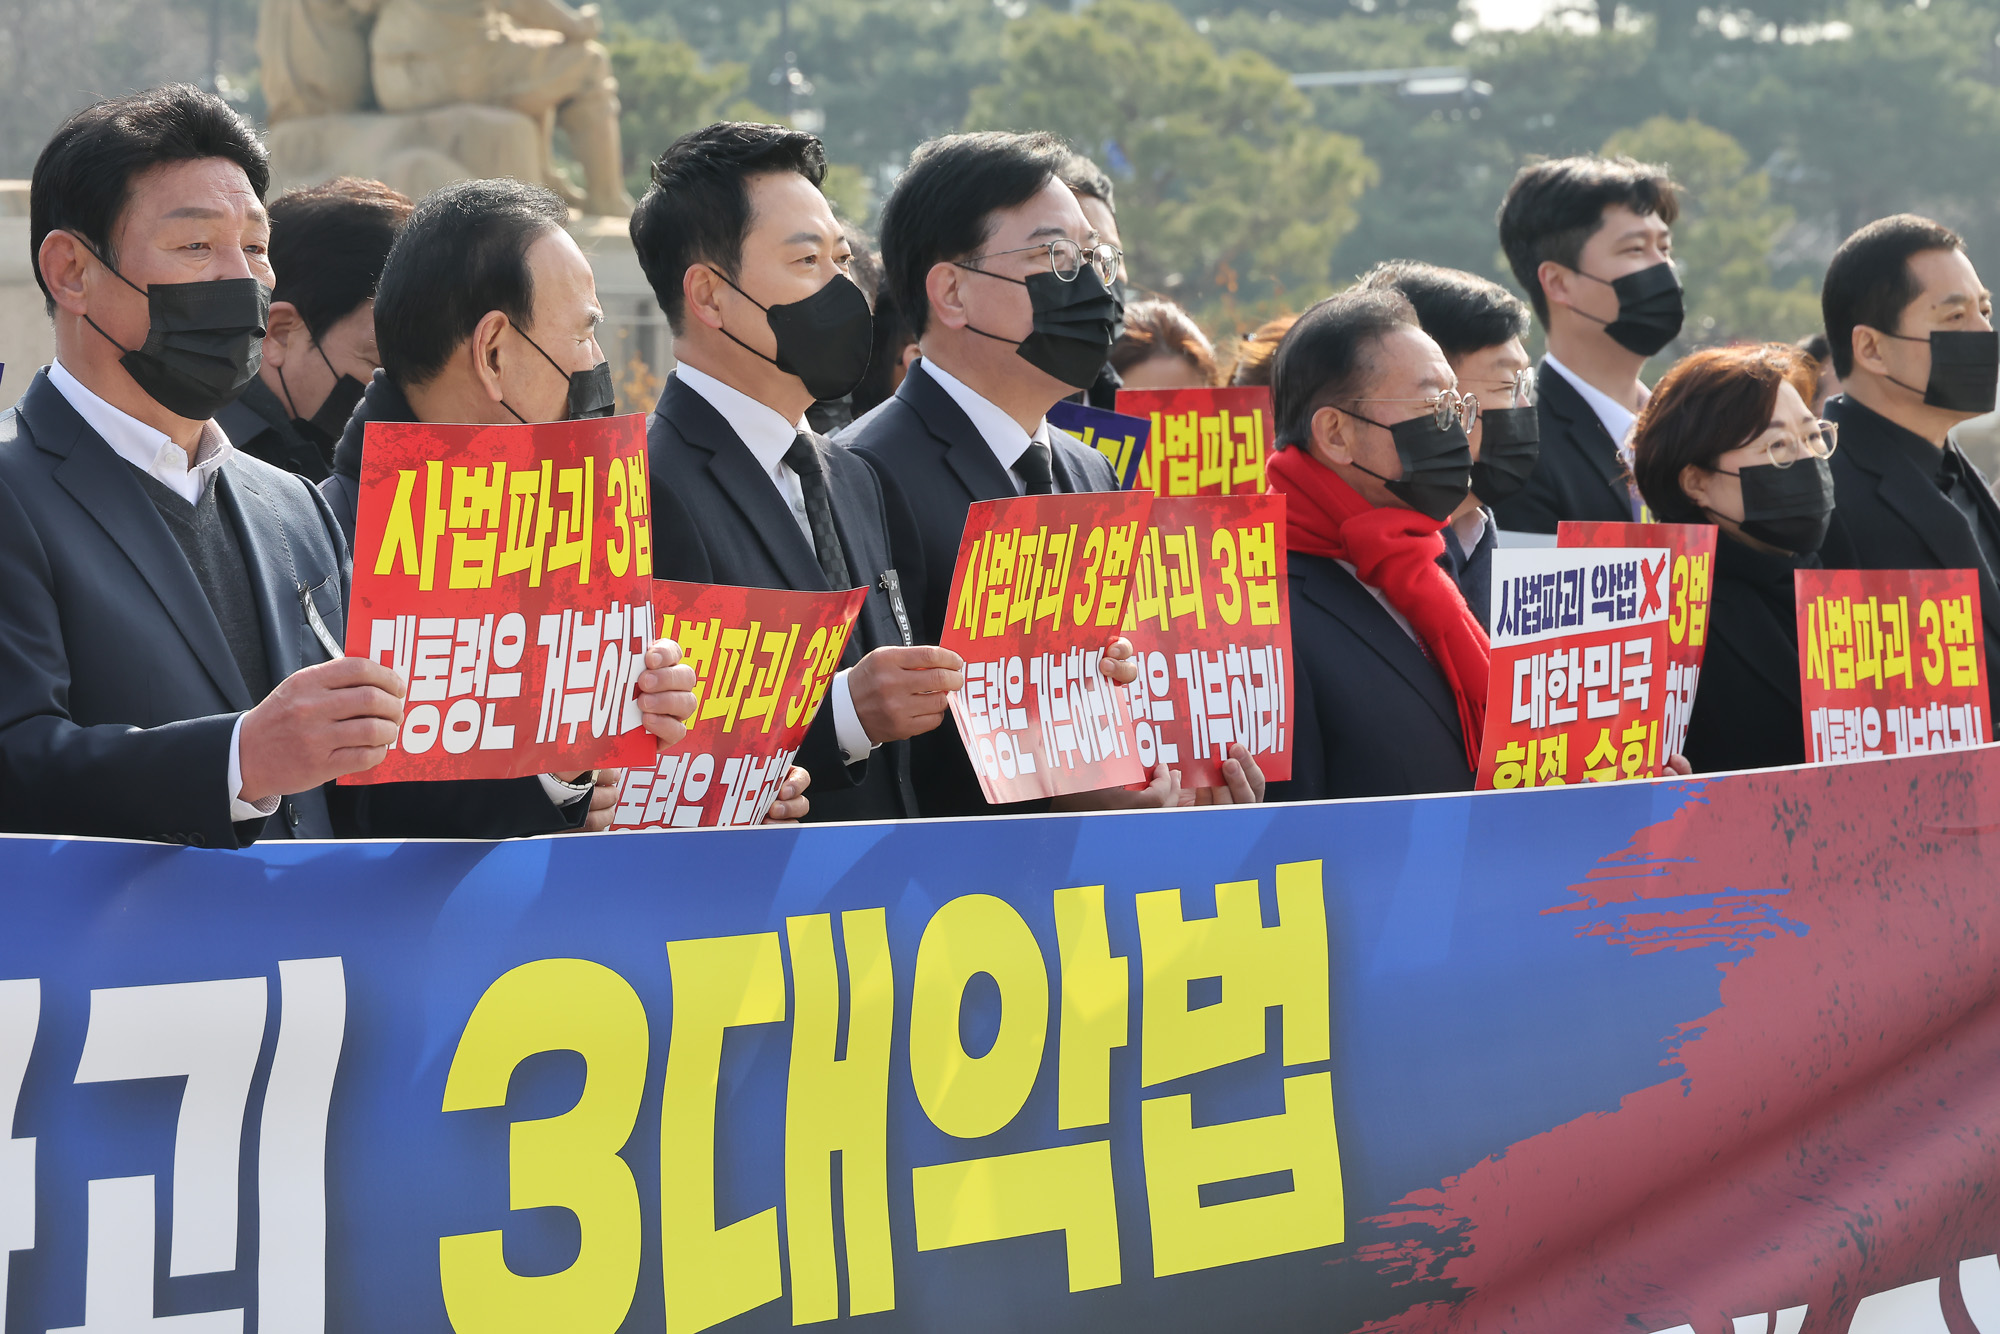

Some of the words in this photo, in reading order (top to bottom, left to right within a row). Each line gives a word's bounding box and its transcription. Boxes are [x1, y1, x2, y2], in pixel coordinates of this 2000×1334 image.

[373, 455, 594, 591] 사법파괴
[606, 449, 652, 580] 3법
[1121, 525, 1206, 631] 파괴
[1211, 522, 1280, 626] 3법
[953, 522, 1078, 640] 사법파괴
[1073, 520, 1139, 627] 3법
[1496, 567, 1585, 637] 사법파괴
[1591, 560, 1637, 622] 악법
[1668, 551, 1709, 647] 3법
[661, 613, 802, 734] 법파괴
[785, 617, 852, 729] 3법
[1511, 636, 1653, 729] 대한민국
[1807, 594, 1913, 690] 사법파괴
[1919, 594, 1979, 687] 3법
[1175, 643, 1286, 761] 거부하라!
[439, 859, 1346, 1334] 3대악법
